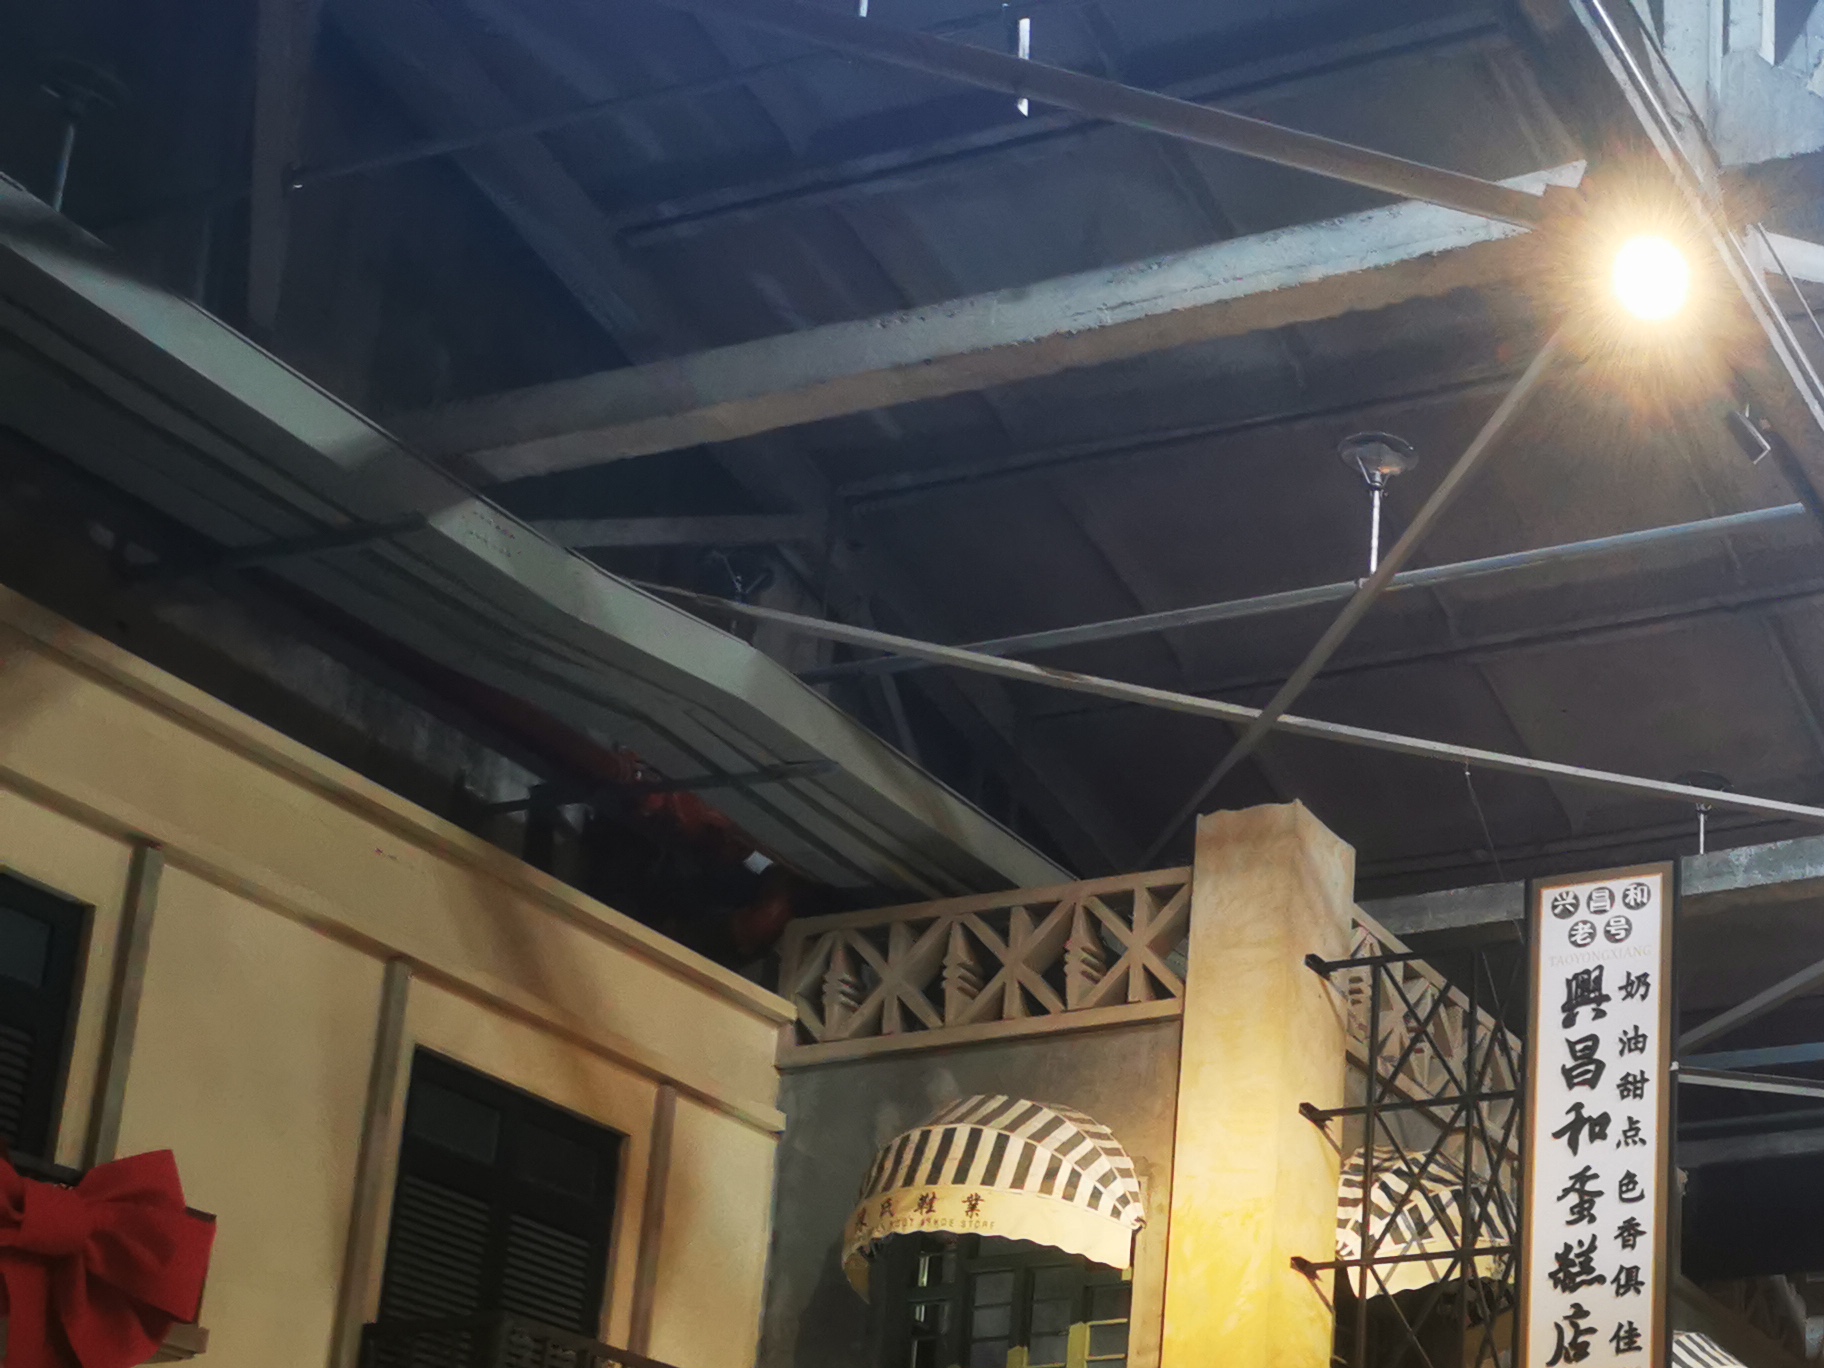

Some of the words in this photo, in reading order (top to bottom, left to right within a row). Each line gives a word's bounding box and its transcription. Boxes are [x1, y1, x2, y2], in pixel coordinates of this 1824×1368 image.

[1551, 883, 1650, 916] 兴昌和
[1568, 915, 1631, 946] 老号
[1608, 970, 1652, 1356] 奶油甜点色香俱佳
